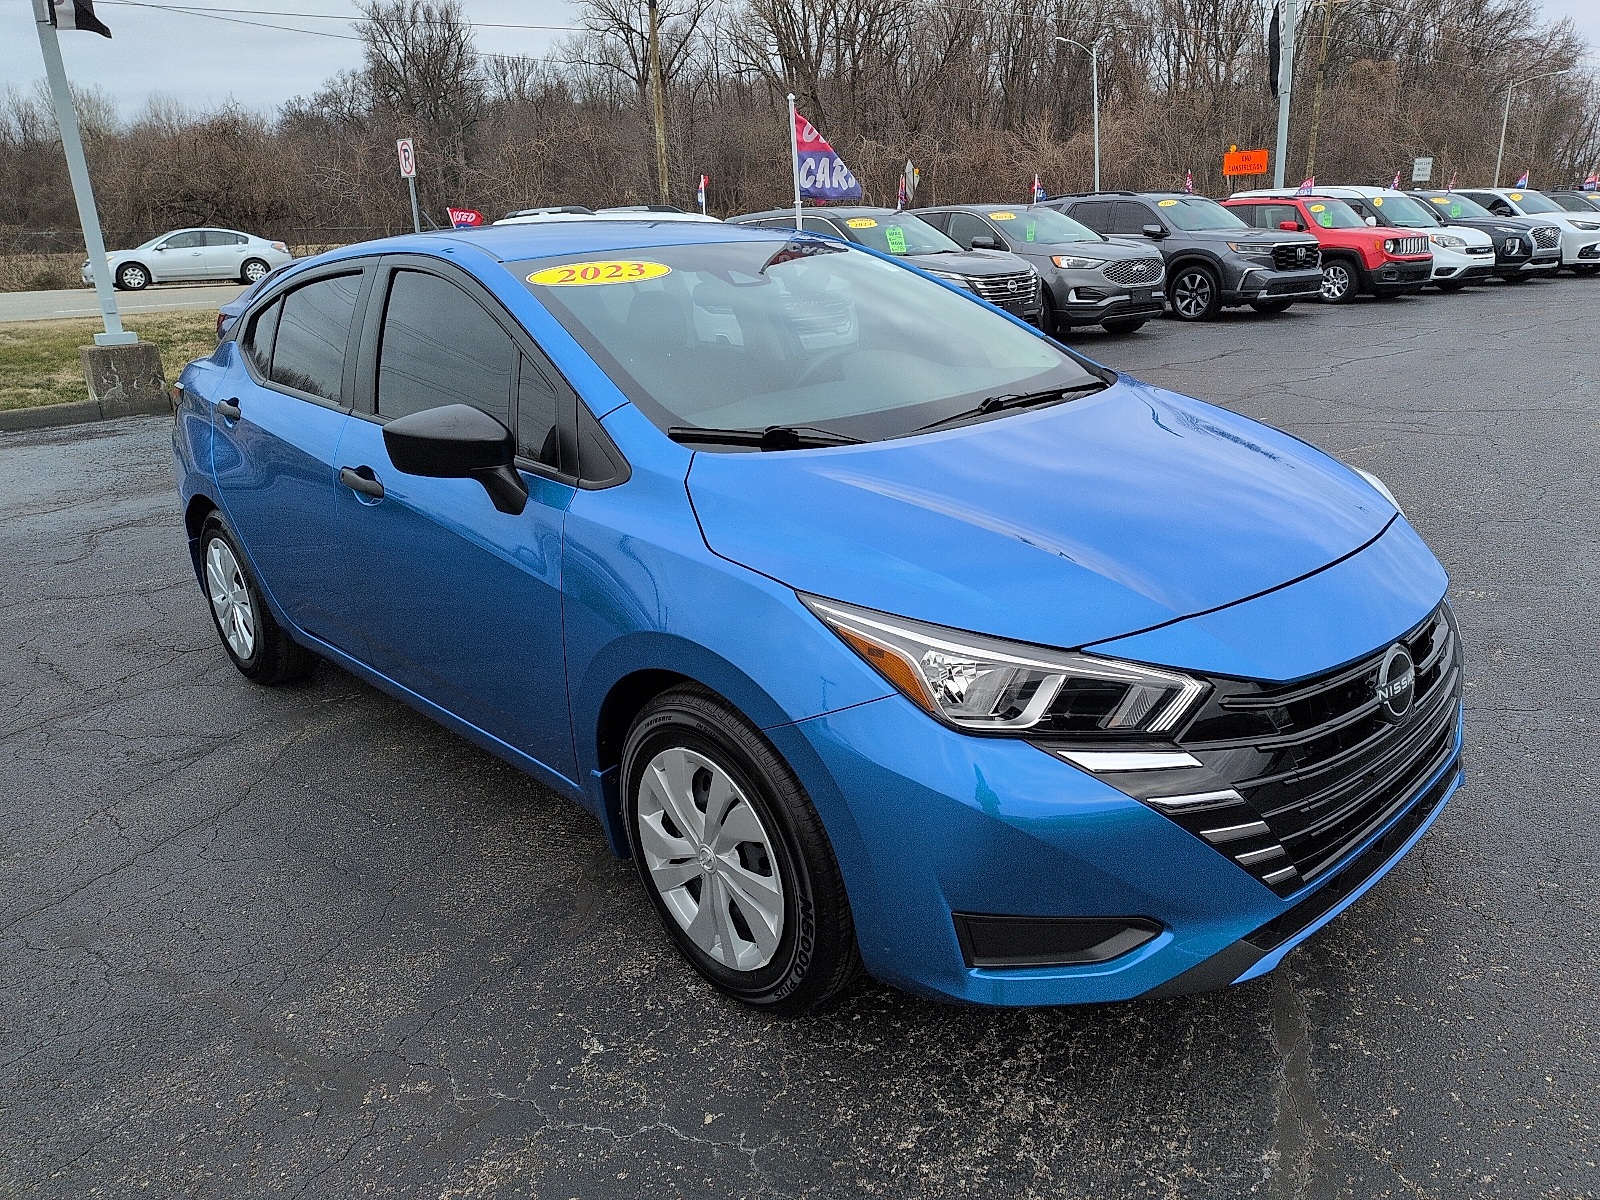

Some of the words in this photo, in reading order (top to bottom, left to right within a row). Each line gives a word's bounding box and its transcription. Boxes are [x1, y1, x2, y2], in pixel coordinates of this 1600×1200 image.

[1241, 154, 1252, 162] END
[453, 211, 476, 223] USED
[556, 263, 646, 283] 2023
[1378, 673, 1413, 700] NISSA
[793, 895, 815, 980] N5000
